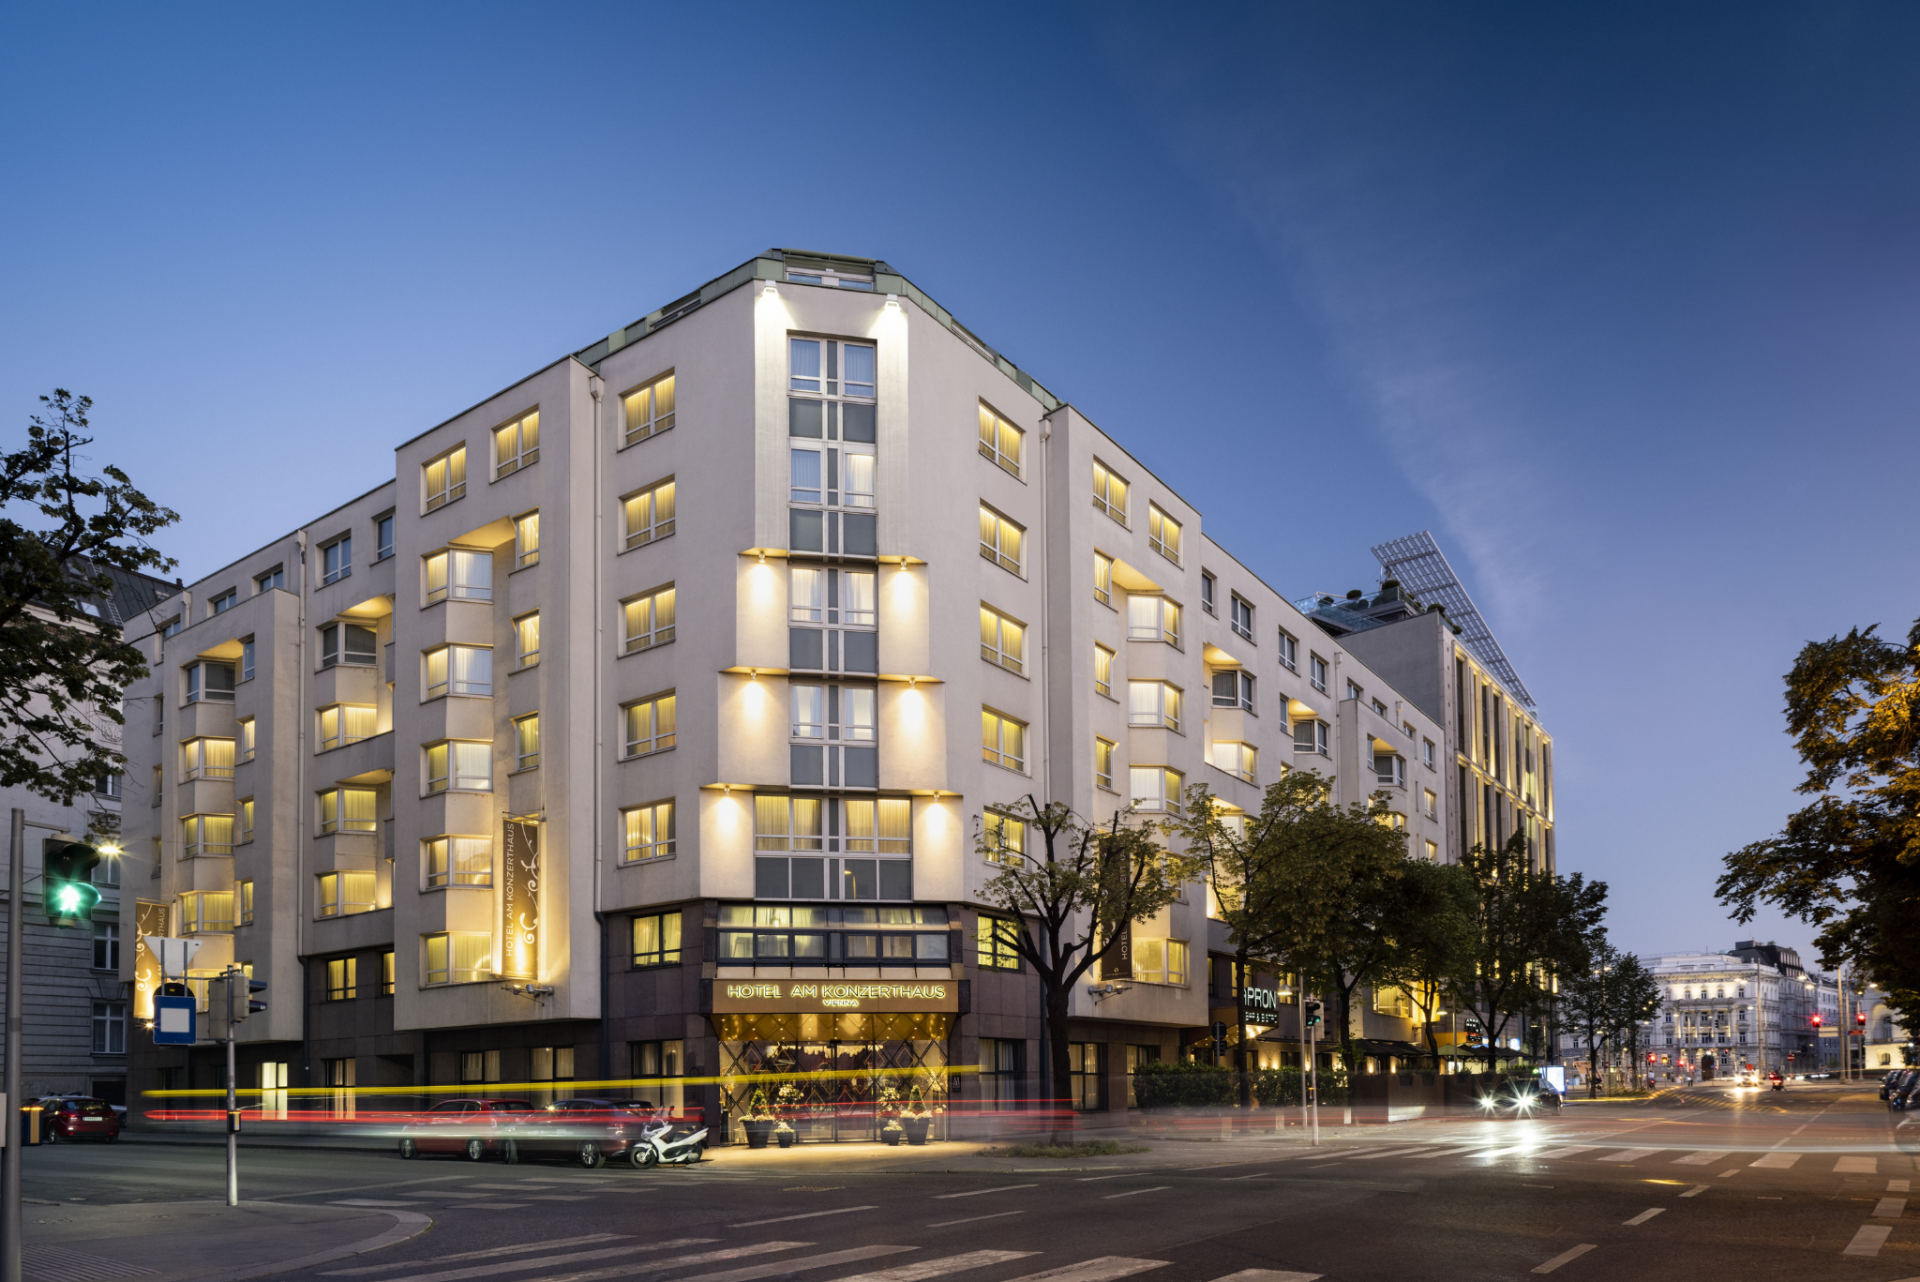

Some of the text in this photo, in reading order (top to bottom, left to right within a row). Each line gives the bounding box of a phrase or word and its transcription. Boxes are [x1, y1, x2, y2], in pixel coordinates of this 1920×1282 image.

[506, 823, 514, 957] HOTEL AM KONZERTHAUS
[727, 985, 945, 998] HOTEL AM KONZERTHAUS
